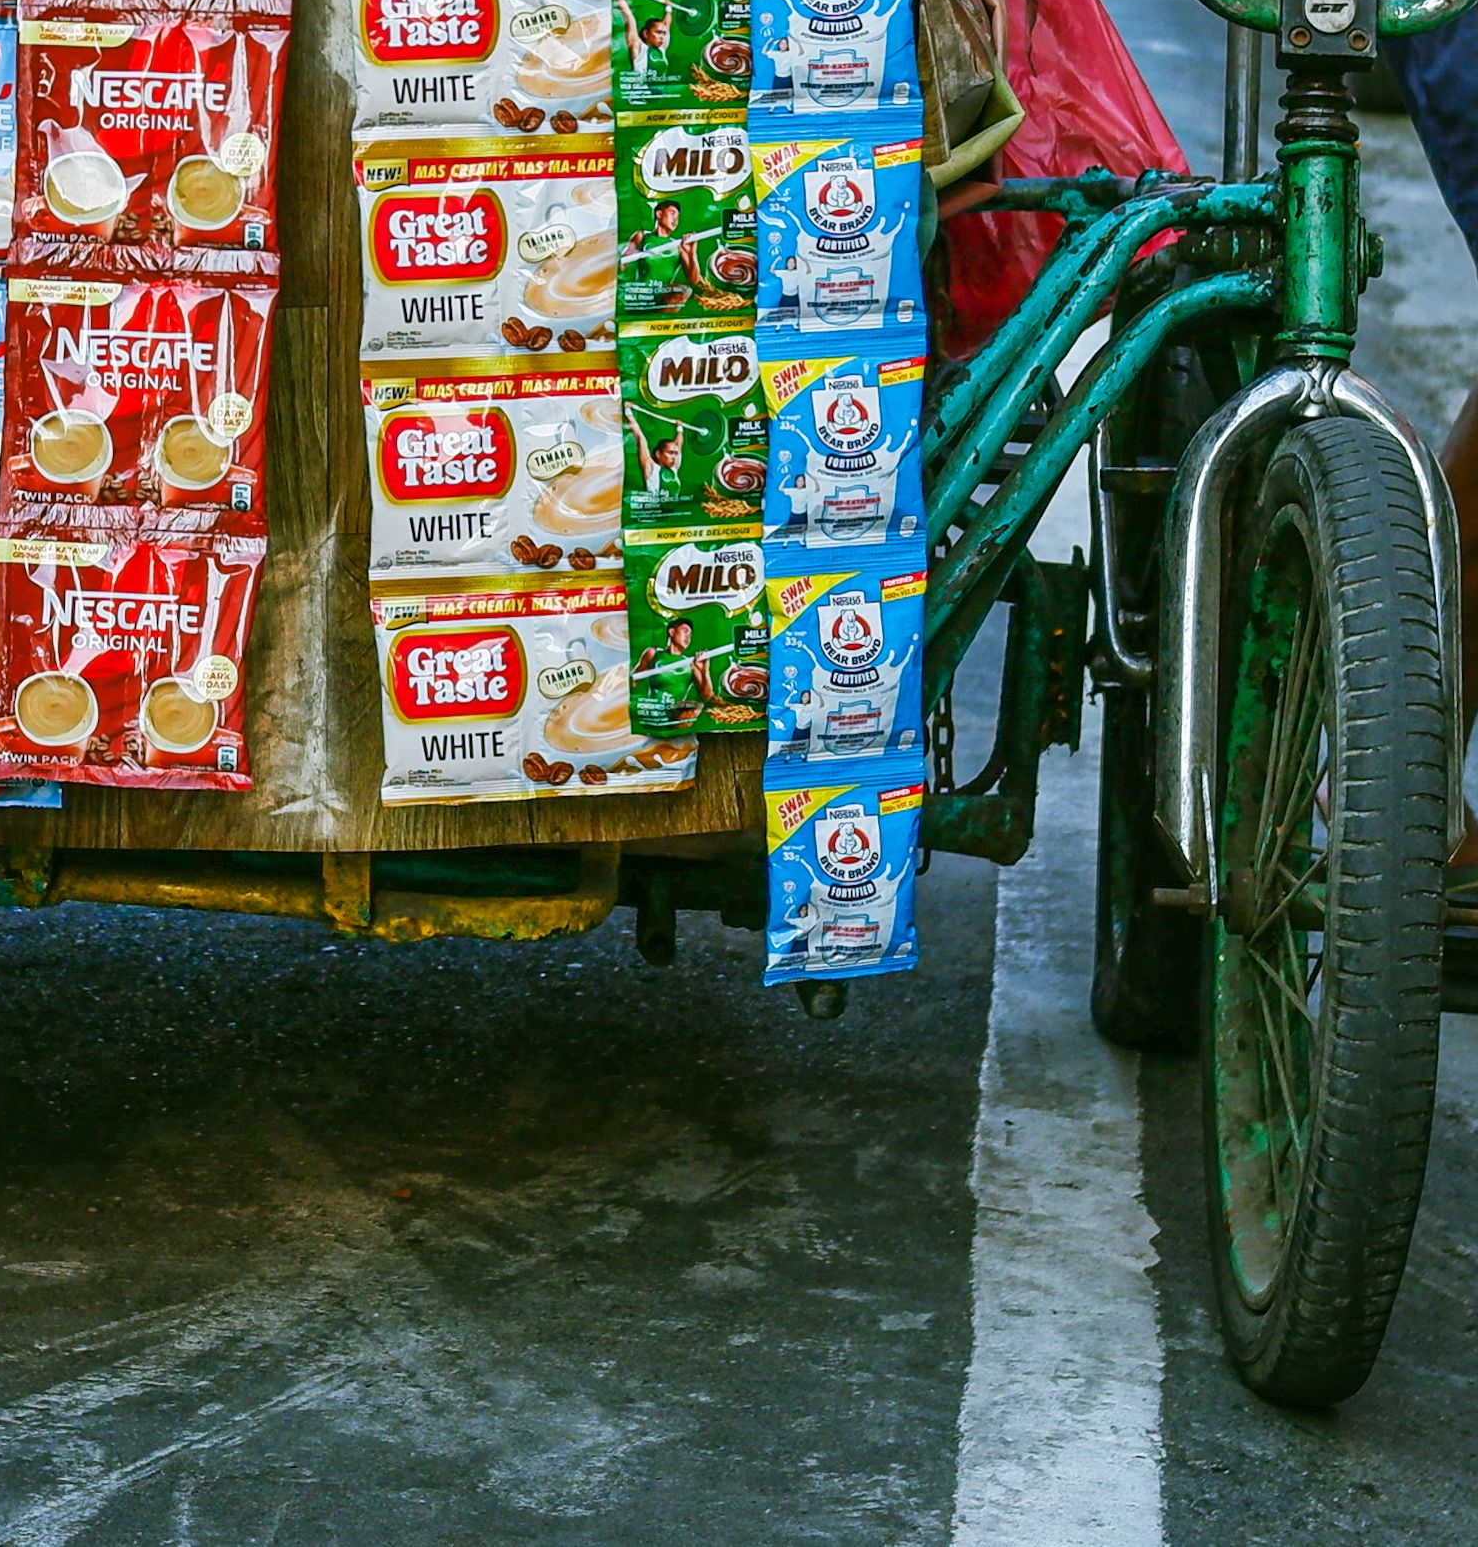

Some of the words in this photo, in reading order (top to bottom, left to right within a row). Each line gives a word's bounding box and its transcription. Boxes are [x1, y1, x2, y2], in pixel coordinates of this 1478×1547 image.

[1310, 2, 1349, 14] GT
[382, 17, 480, 47] Taste
[810, 17, 861, 33] FORTIFIED
[393, 74, 475, 104] WHITE
[100, 113, 194, 132] ORIGINAL
[366, 167, 402, 182] NEW!
[414, 163, 446, 179] MAS
[514, 161, 545, 175] MAS
[653, 147, 744, 176] MILO
[389, 206, 487, 237] Great
[810, 205, 838, 232] BEAR
[839, 204, 874, 232] BRAND
[390, 237, 487, 267] Taste
[818, 236, 868, 252] FORTIFIED
[401, 294, 484, 323] WHITE
[650, 320, 668, 330] NOW
[671, 320, 696, 329] MORE
[698, 319, 744, 330] DELICIOUS
[86, 373, 182, 392] ORIGINAL
[659, 355, 751, 387] MILO
[772, 360, 808, 390] SWAK
[776, 379, 800, 402] PACK
[739, 421, 761, 431] MILK
[818, 426, 846, 449] BEAR
[847, 423, 879, 450] BRAND
[397, 426, 496, 457] Great
[398, 456, 497, 486] Taste
[826, 452, 876, 469] FORTIFIED
[16, 490, 50, 503] TWIN
[54, 491, 92, 504] PACK
[409, 513, 492, 543] WHITE
[667, 563, 757, 595] MILO
[780, 575, 813, 605] SWAK
[784, 596, 807, 618] PACK
[72, 633, 168, 653] ORIGINAL
[822, 641, 850, 666] BEAR
[851, 637, 882, 666] BRAND
[407, 644, 507, 676] Great
[199, 680, 234, 690] ROAST
[203, 671, 231, 681] DARK
[546, 666, 585, 684] TAMANG
[831, 669, 879, 685] FORTIFIED
[409, 675, 508, 704] Taste
[421, 731, 504, 761] WHITE
[778, 790, 811, 819] SWAK
[782, 811, 806, 834] PACK
[819, 854, 848, 880] BEAR
[849, 851, 880, 880] BRAND
[830, 884, 875, 900] FORTIFIED
